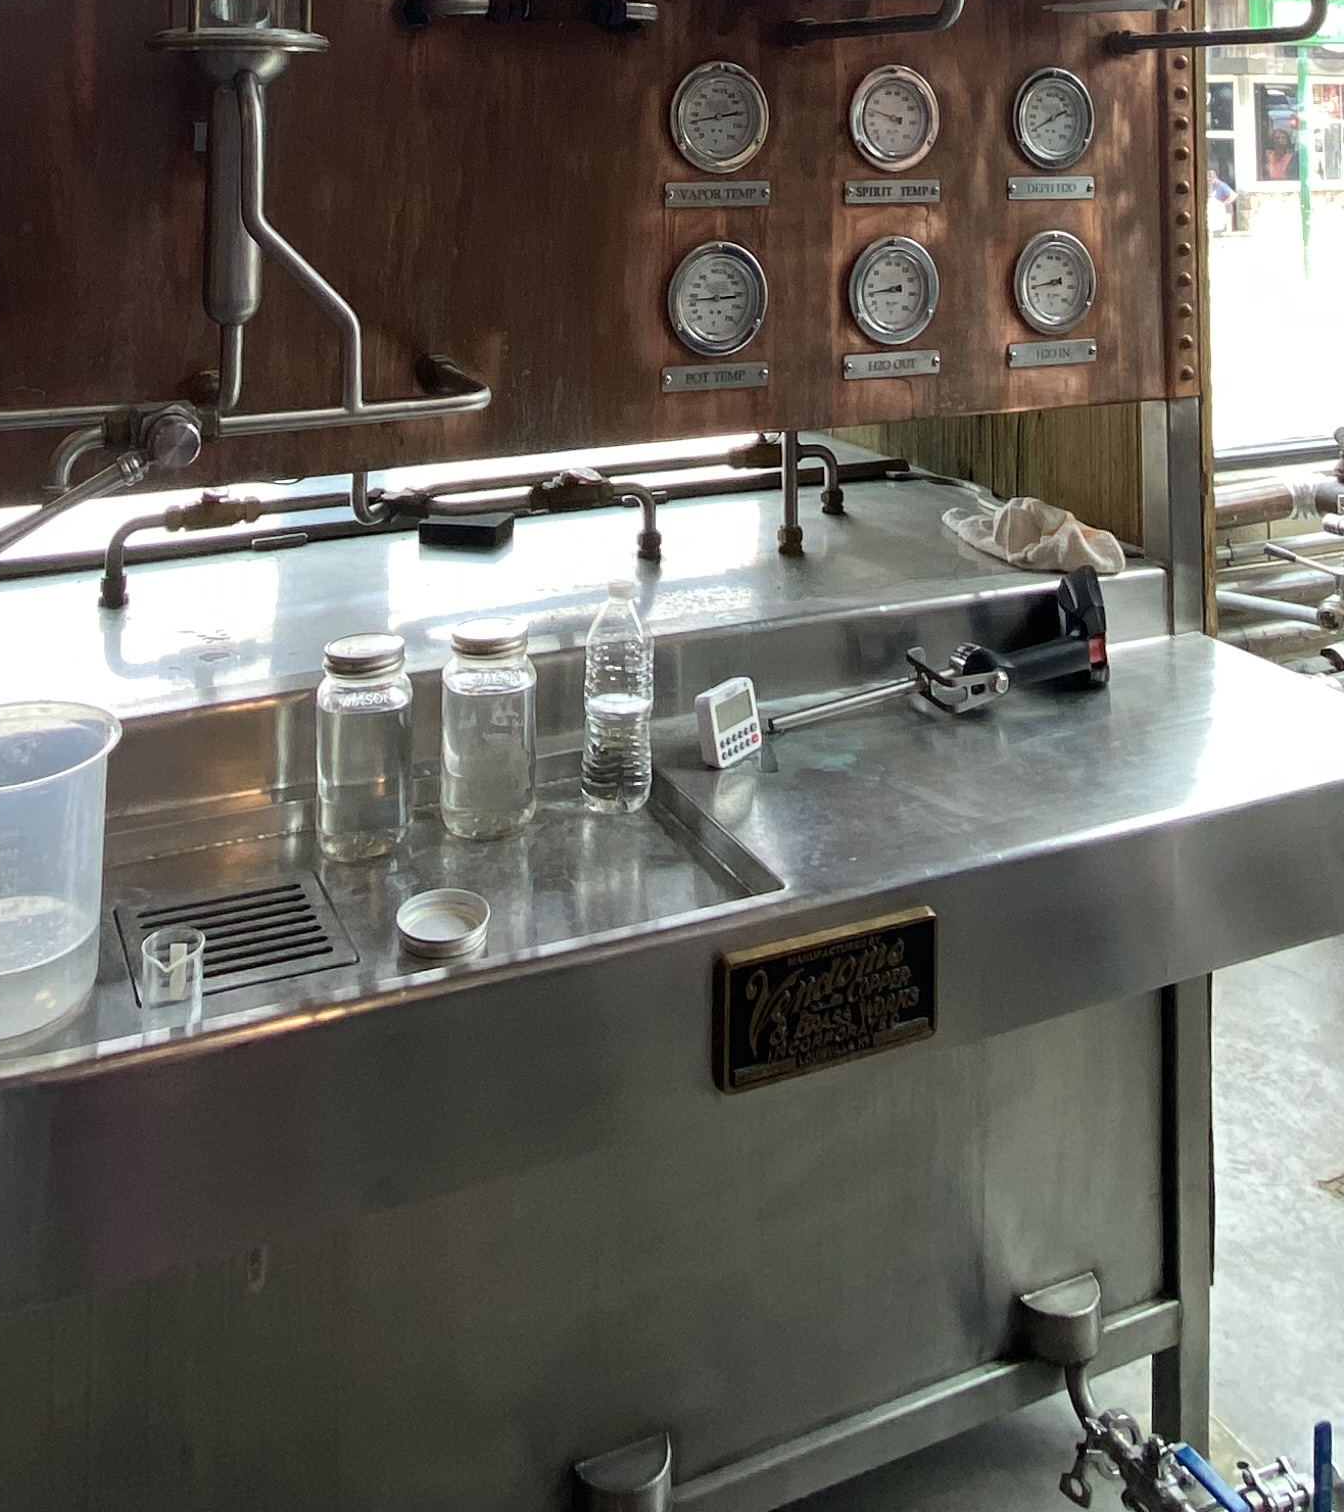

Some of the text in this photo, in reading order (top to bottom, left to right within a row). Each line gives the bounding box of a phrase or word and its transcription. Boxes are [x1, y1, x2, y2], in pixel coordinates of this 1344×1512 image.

[680, 187, 757, 201] VAPOR TEMP
[856, 185, 929, 197] SPIRIT TEMP
[1058, 347, 1071, 359] IN
[868, 359, 917, 372] H2O OUT
[686, 370, 746, 385] POT TEMP
[344, 690, 392, 708] MASON
[847, 965, 912, 1003] COPPER
[746, 937, 905, 1059] Vendome
